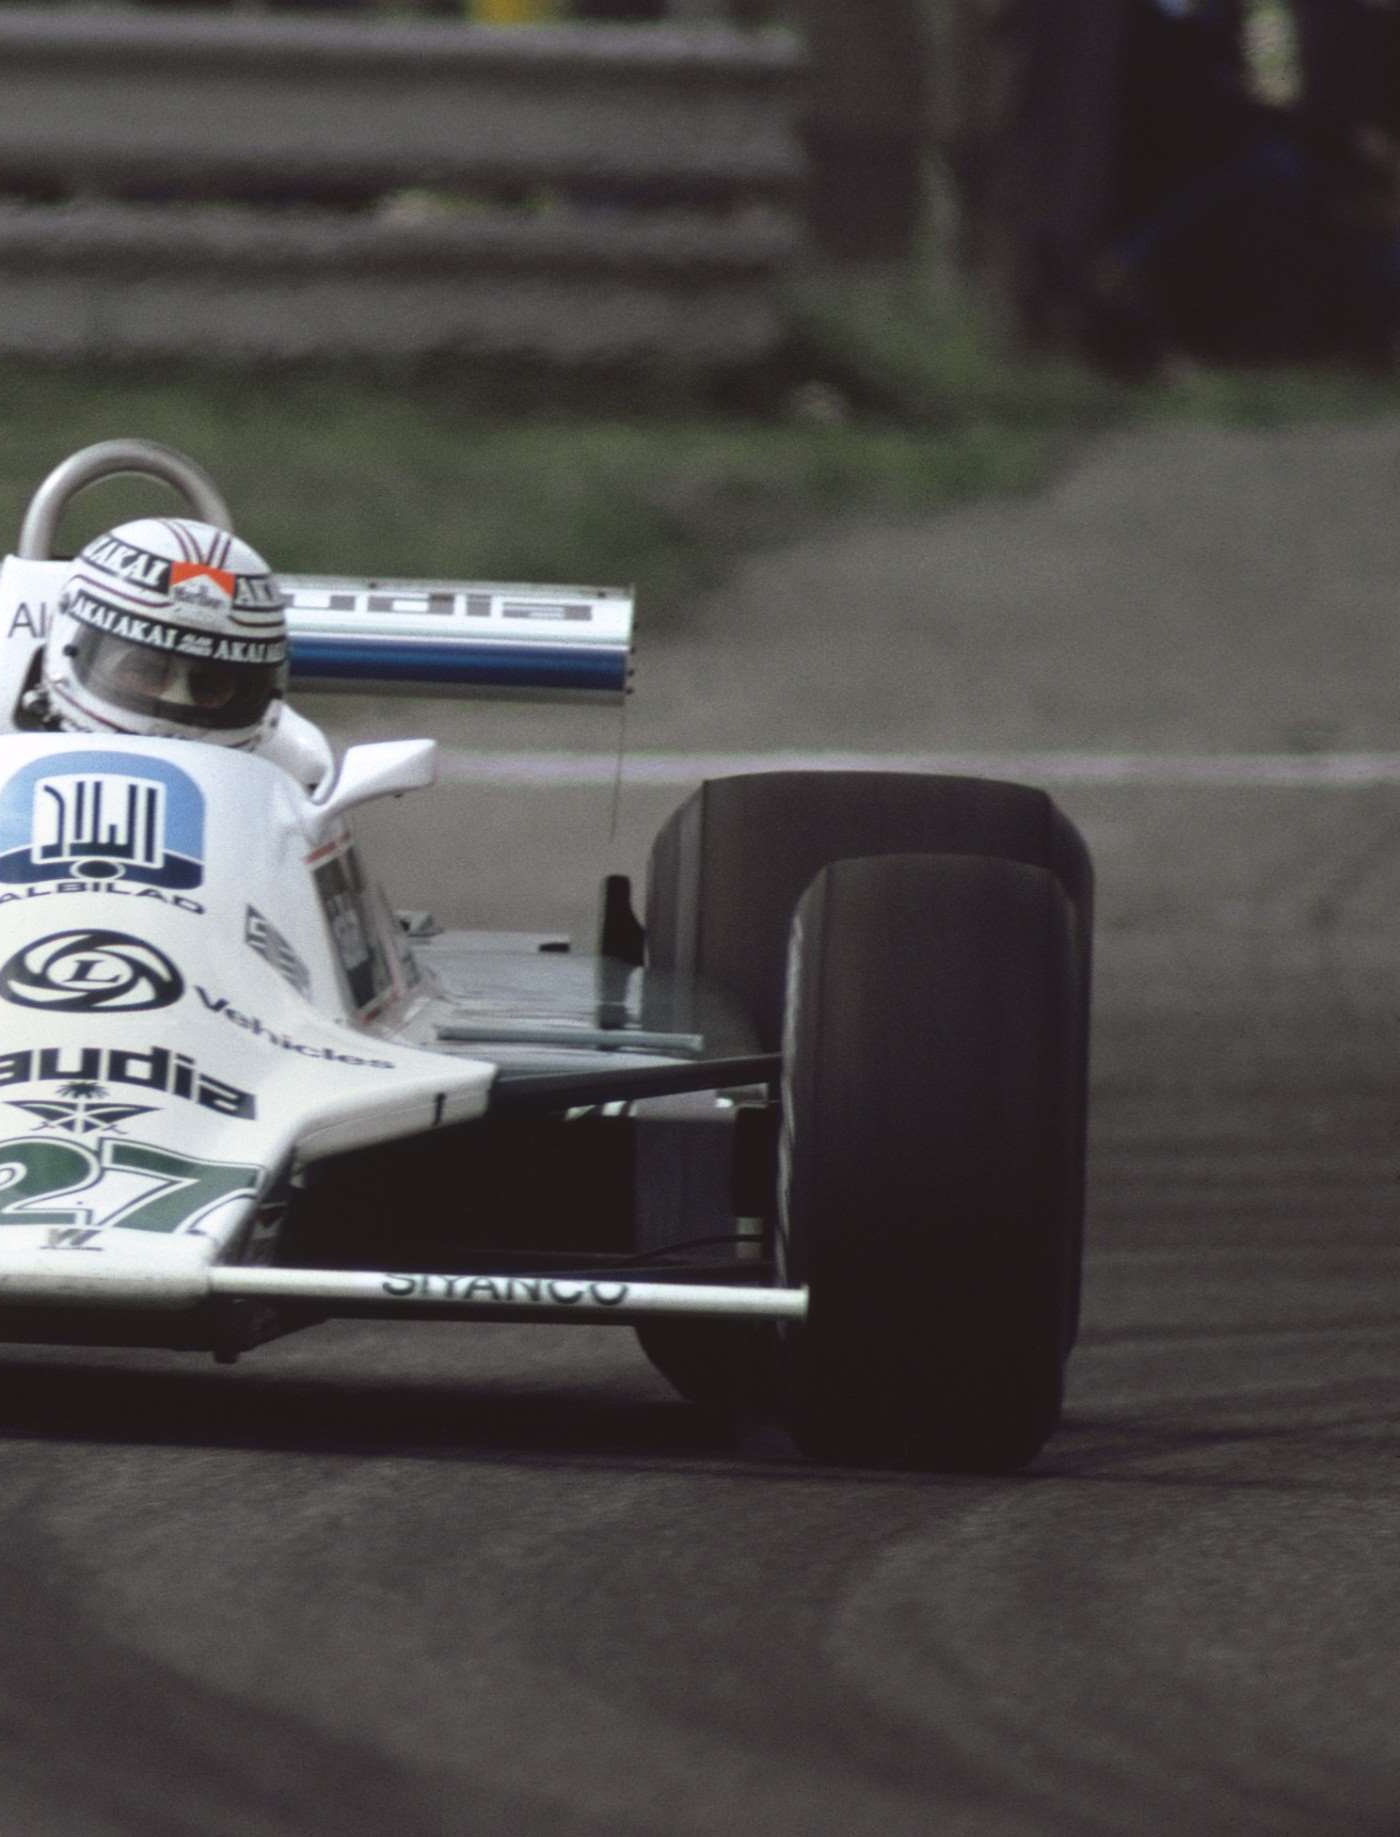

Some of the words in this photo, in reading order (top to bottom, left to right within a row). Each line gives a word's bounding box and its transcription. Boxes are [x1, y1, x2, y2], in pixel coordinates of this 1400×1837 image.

[278, 590, 592, 621] udia
[112, 615, 180, 650] AKAI
[193, 984, 396, 1069] Vehicles
